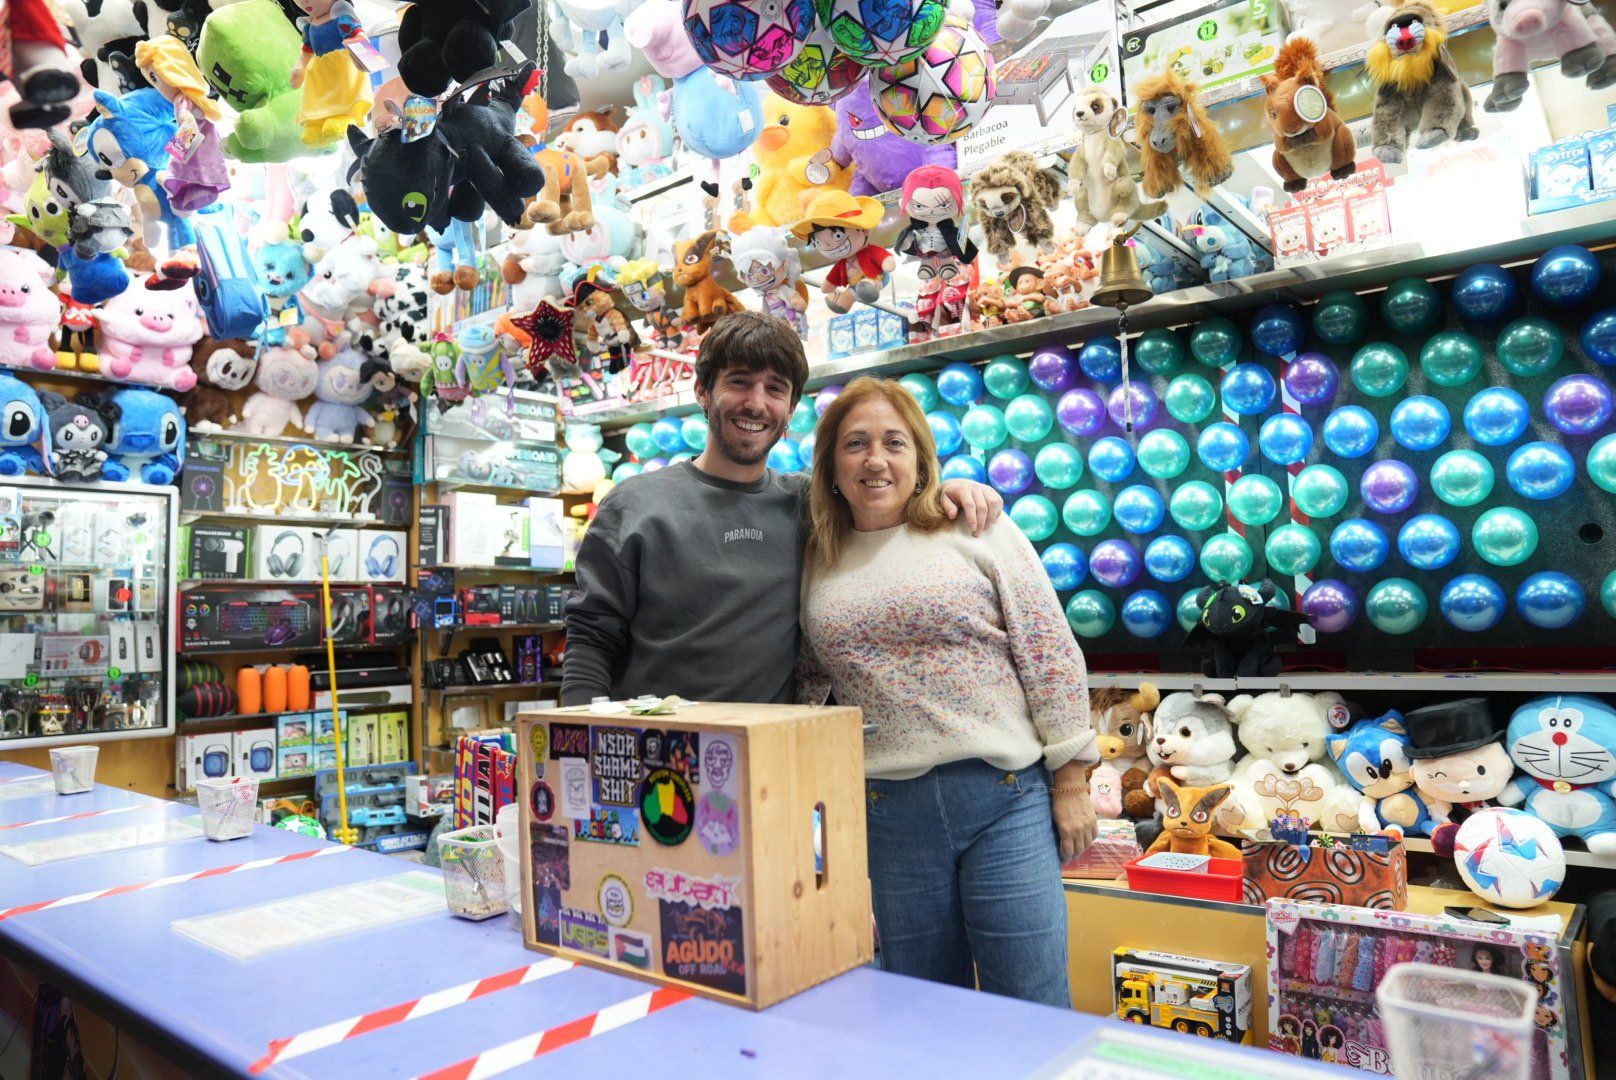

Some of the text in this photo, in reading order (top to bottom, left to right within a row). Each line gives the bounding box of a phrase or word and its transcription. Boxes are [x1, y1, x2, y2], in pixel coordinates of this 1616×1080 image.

[963, 120, 1008, 141] Barbacoa
[963, 135, 1006, 156] Plegable
[724, 528, 763, 544] PARANOIA
[594, 755, 640, 778] SHAME
[601, 778, 634, 803] SHIT
[665, 939, 734, 964] AGUDO
[678, 963, 697, 975] OFF
